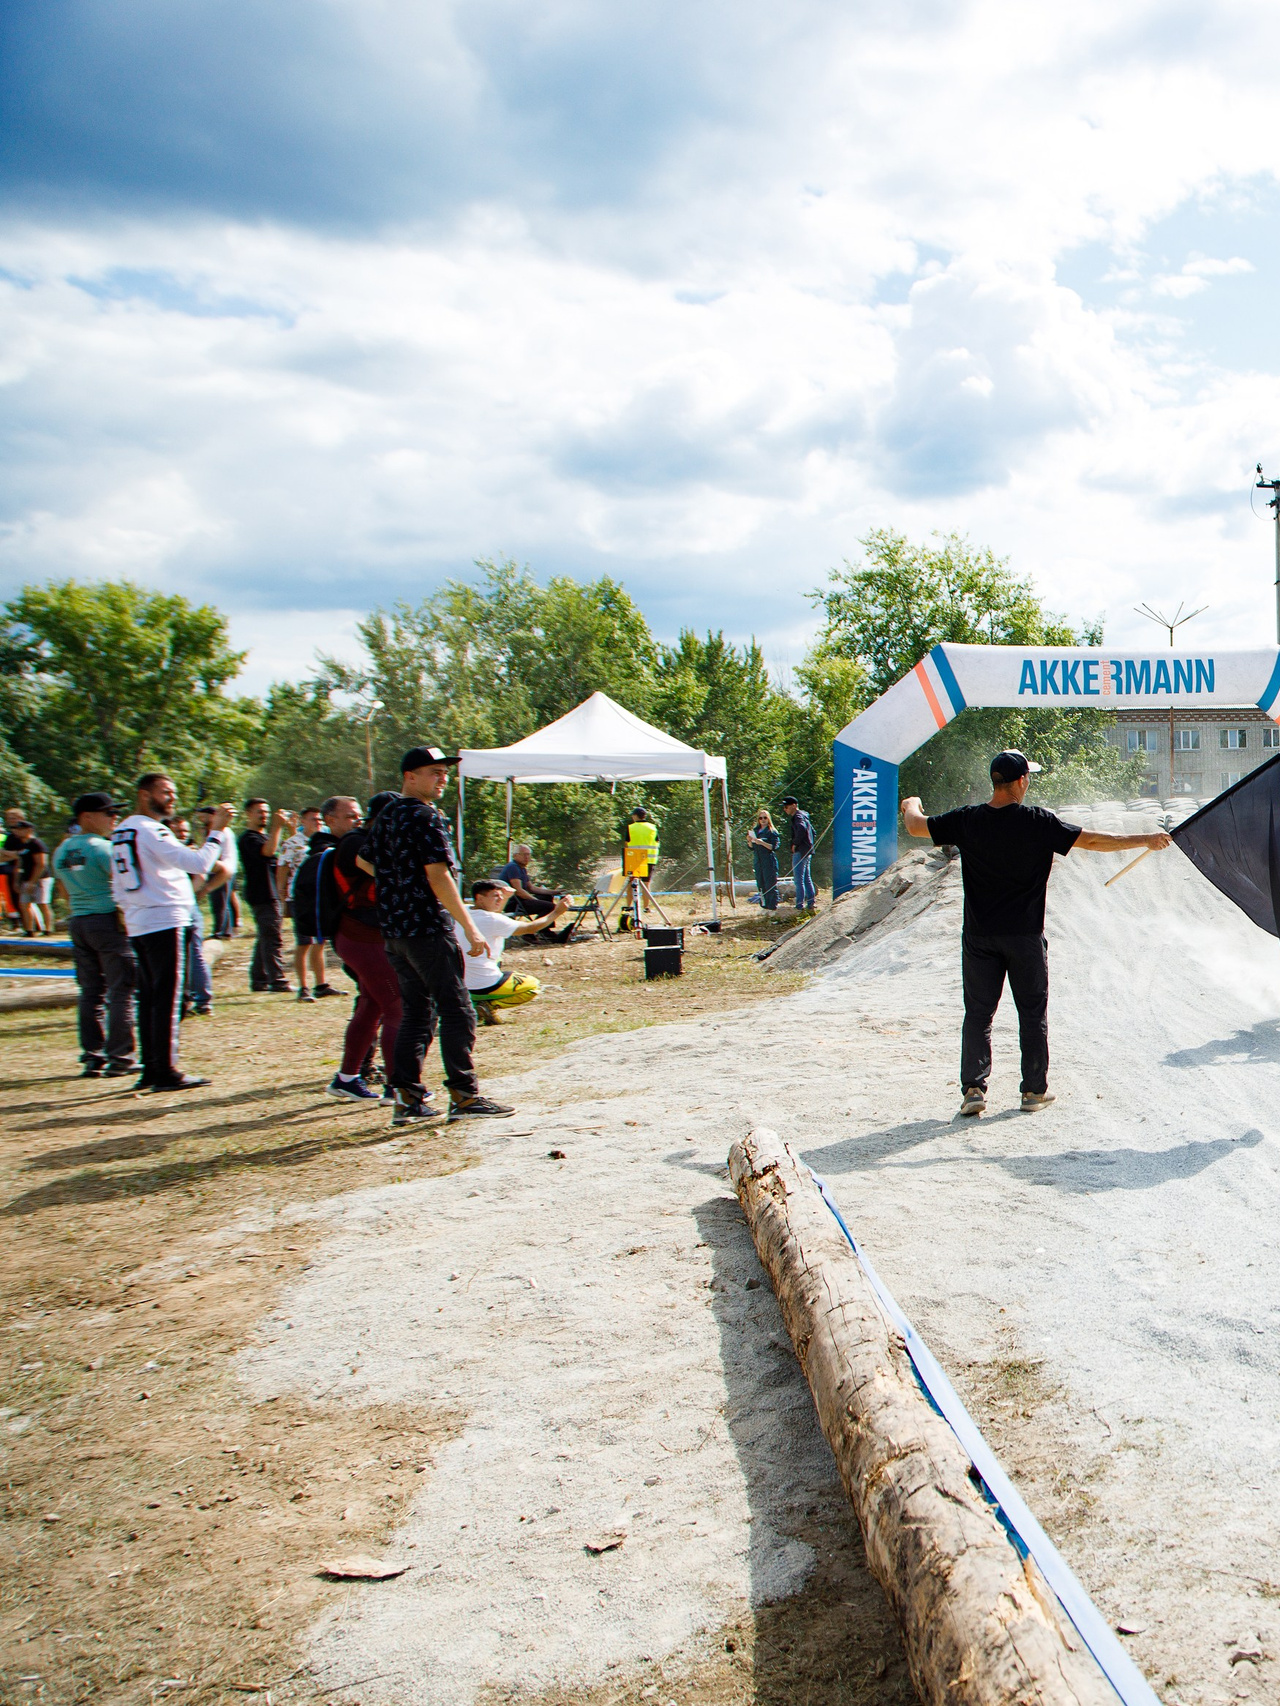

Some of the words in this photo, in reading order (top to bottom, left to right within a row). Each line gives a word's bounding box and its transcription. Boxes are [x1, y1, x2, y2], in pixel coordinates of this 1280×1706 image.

[1018, 659, 1215, 695] AKKERMANN
[1101, 660, 1110, 696] cement
[852, 820, 877, 828] cement
